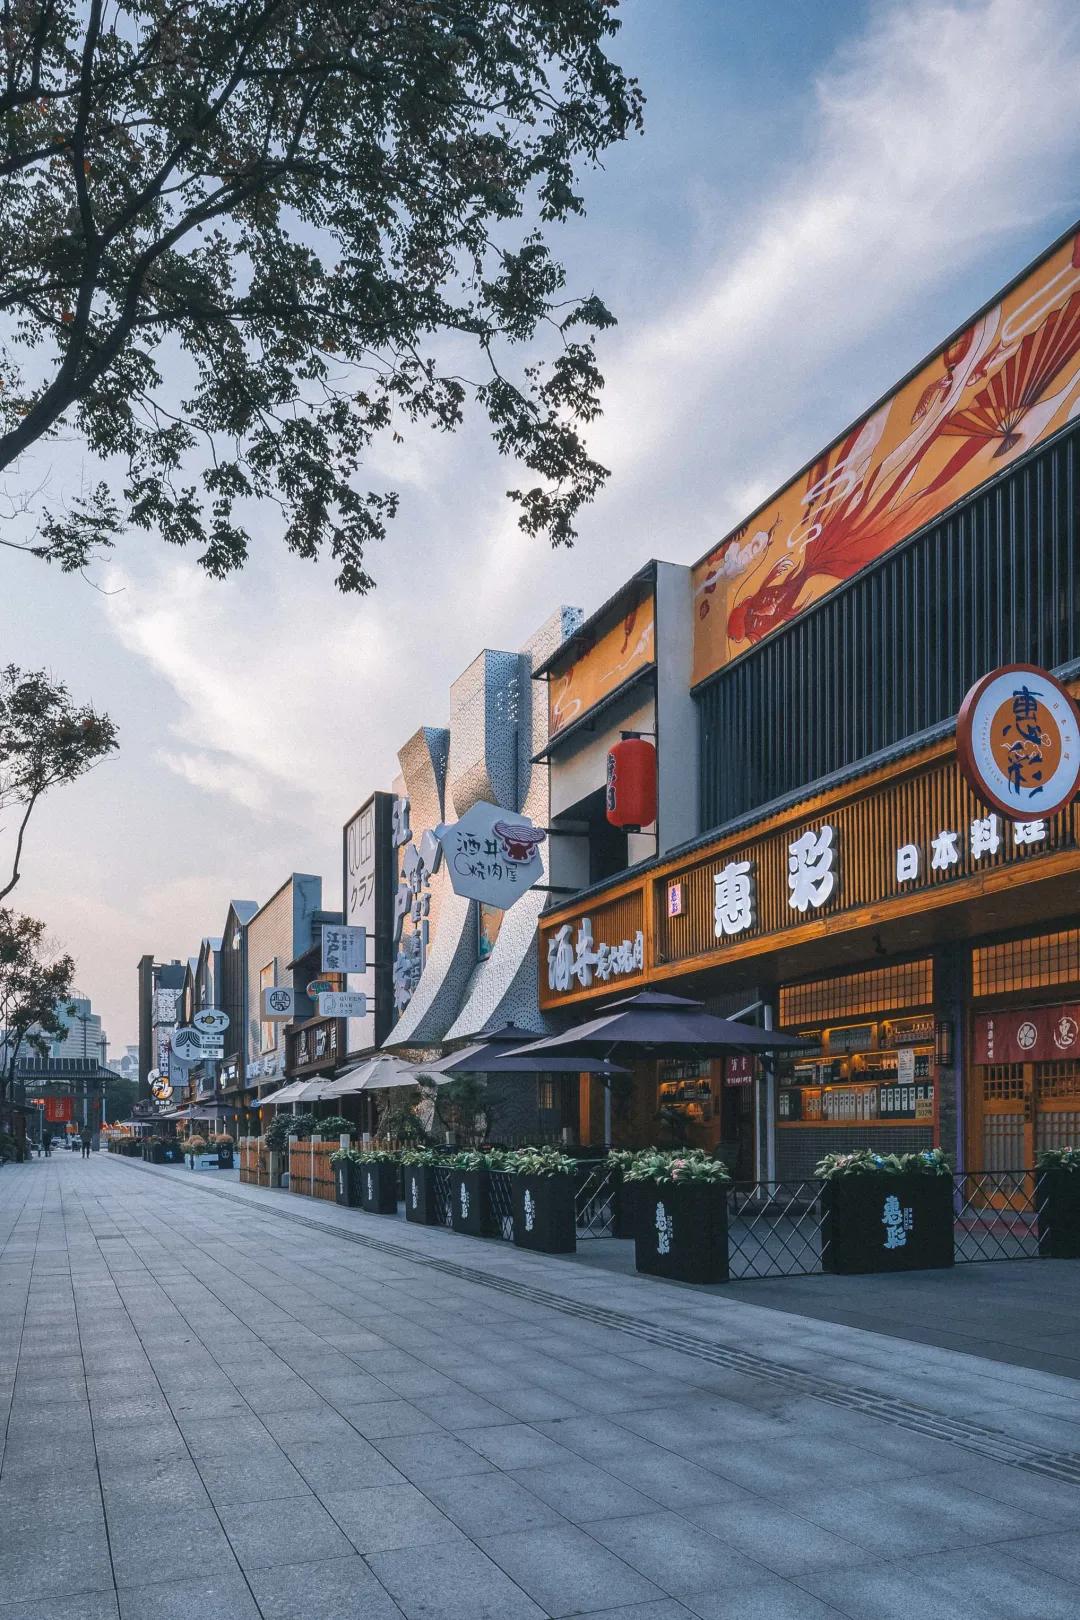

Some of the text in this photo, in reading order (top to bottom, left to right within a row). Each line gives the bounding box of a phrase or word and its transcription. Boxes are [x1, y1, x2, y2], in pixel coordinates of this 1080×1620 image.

[349, 807, 375, 877] QUEE
[456, 831, 502, 858] 酒井
[713, 825, 834, 938] 惠彩
